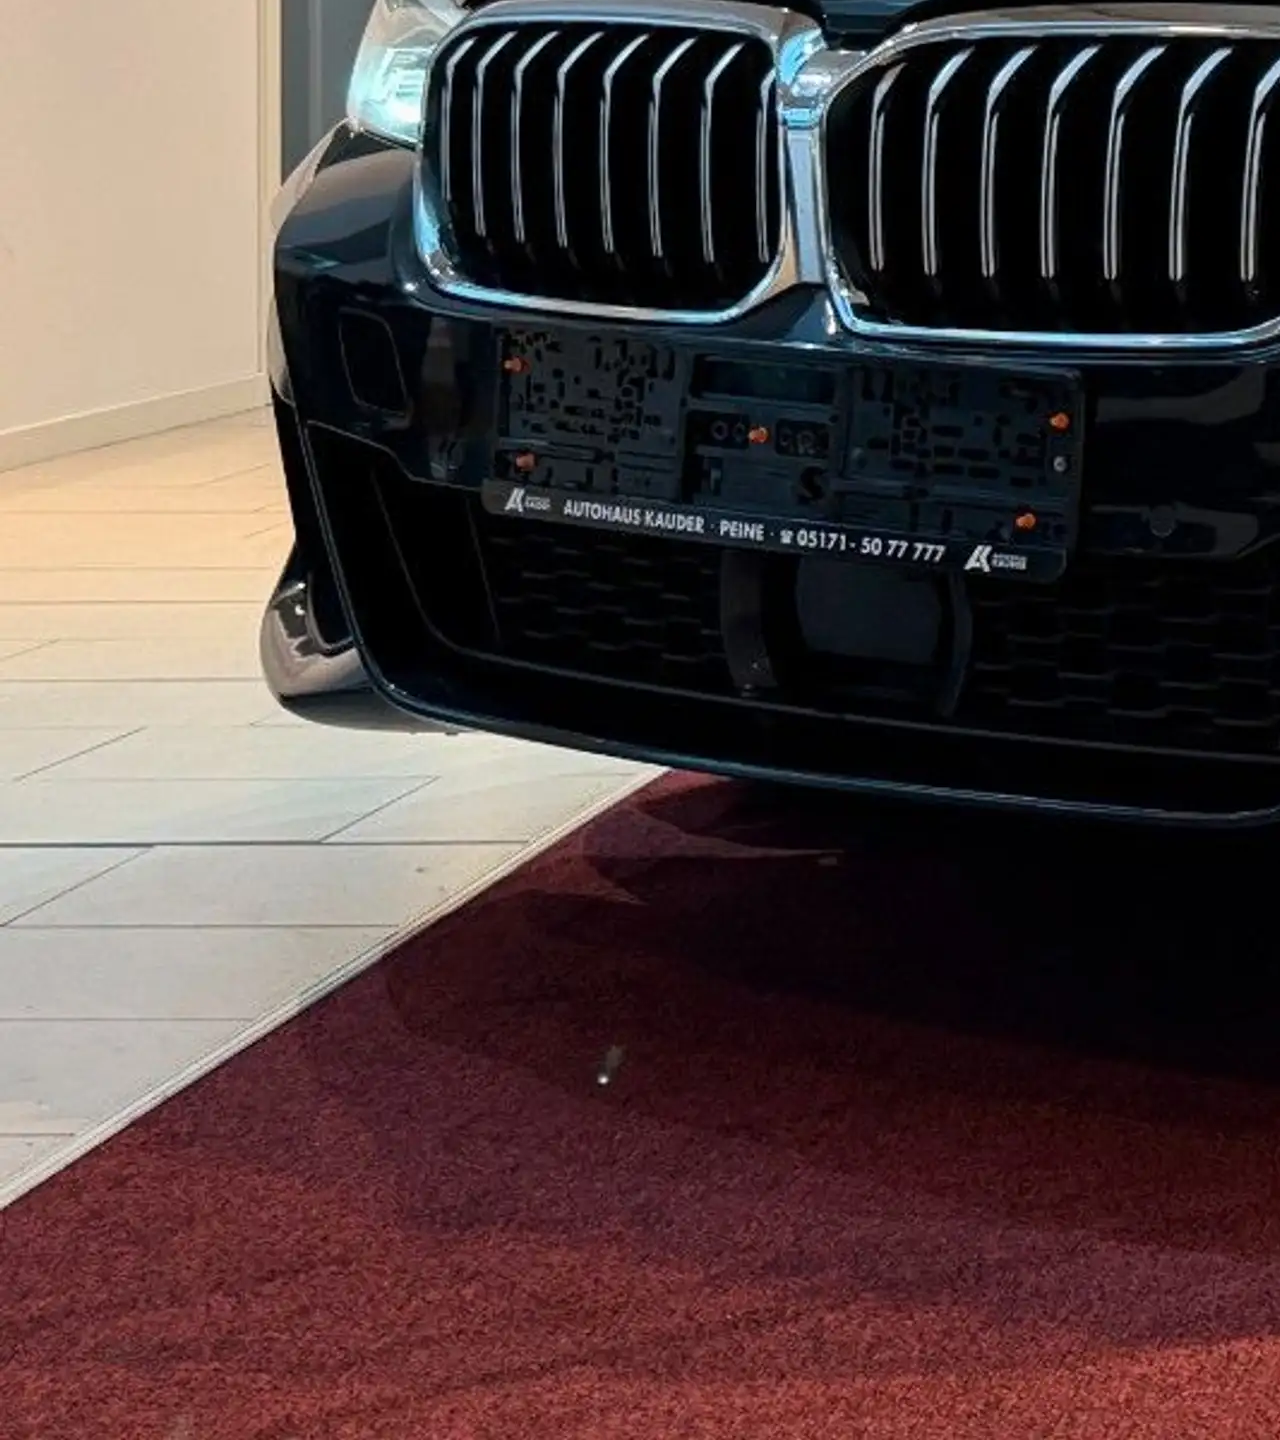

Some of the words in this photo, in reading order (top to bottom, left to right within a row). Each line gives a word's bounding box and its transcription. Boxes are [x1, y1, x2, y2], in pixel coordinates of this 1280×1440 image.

[563, 499, 642, 526] AUTOHAUS
[644, 509, 705, 534] KAUDER
[719, 519, 765, 542] PEINE
[860, 537, 883, 556] 50
[887, 539, 909, 558] 77
[913, 542, 946, 562] 777
